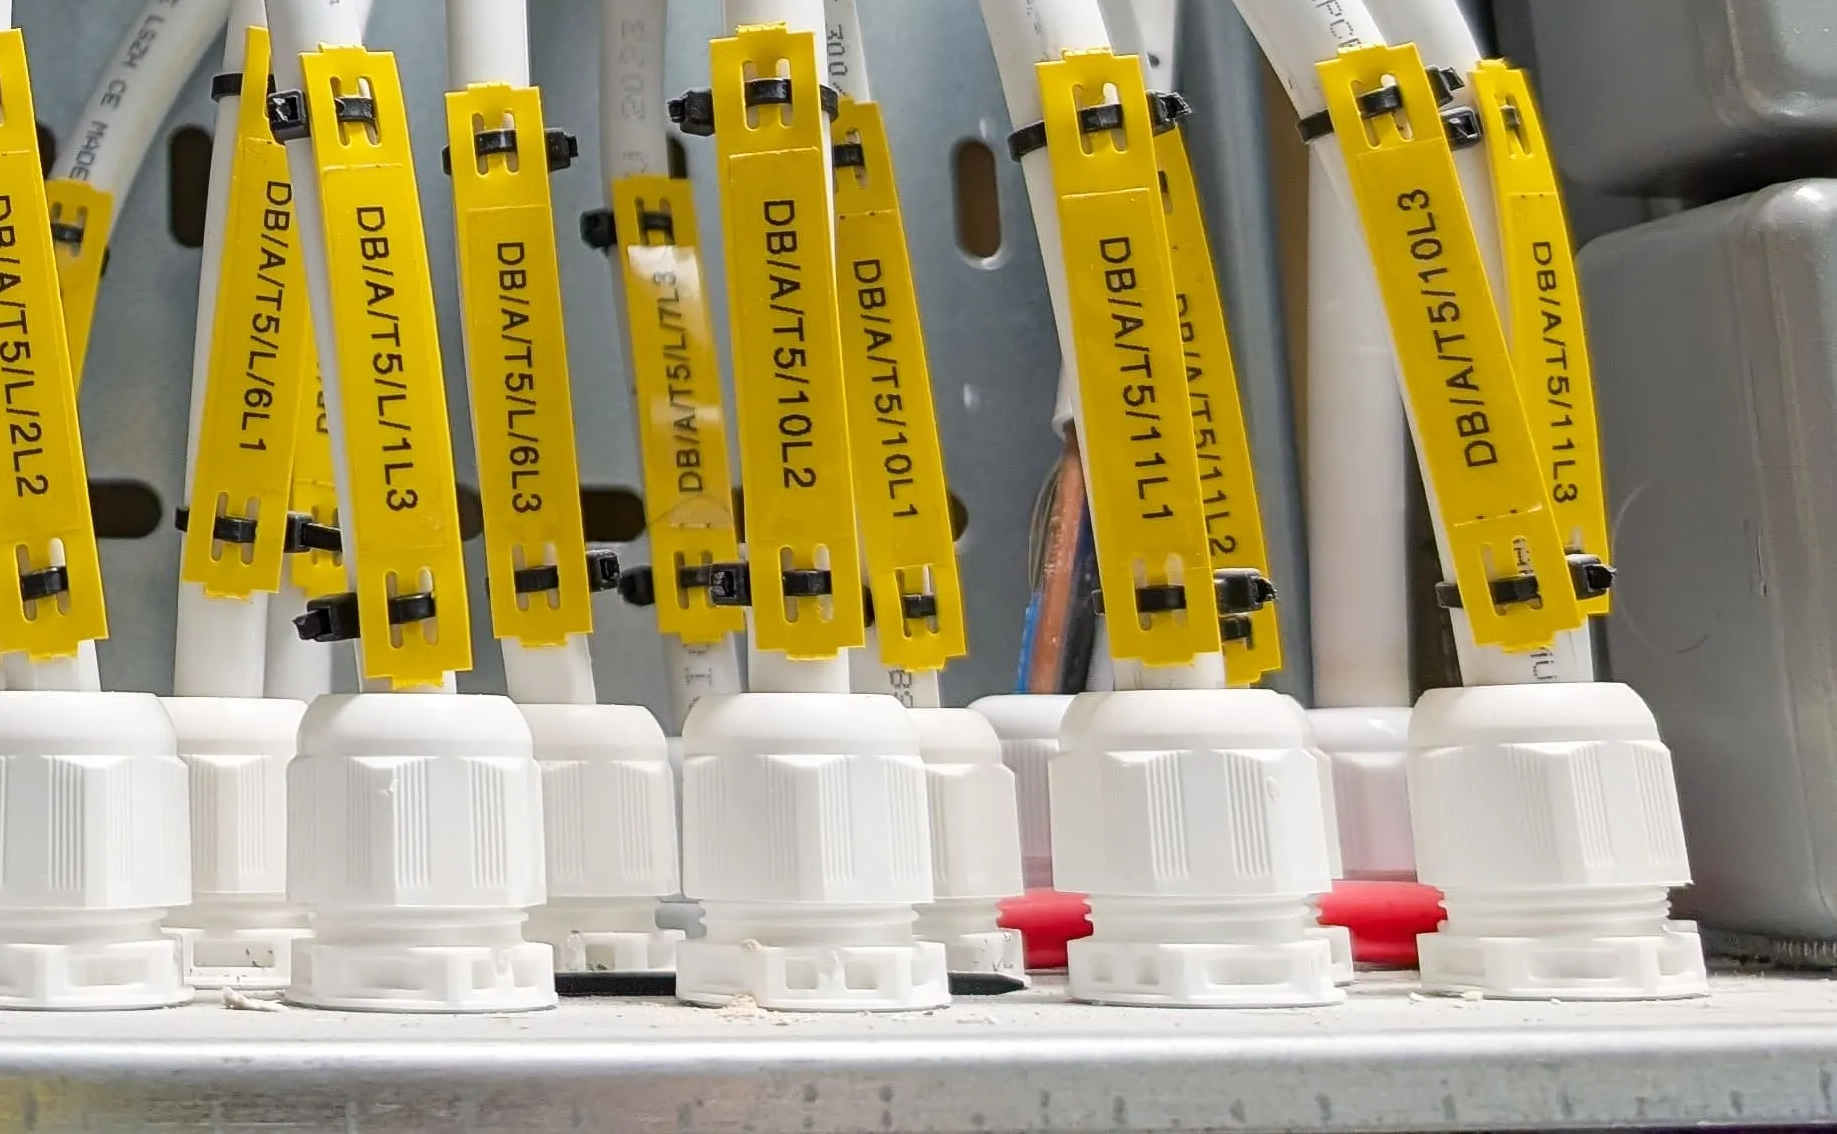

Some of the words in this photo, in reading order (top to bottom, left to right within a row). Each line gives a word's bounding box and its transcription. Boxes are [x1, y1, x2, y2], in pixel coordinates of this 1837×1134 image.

[68, 119, 108, 180] MADE
[99, 78, 128, 110] CE
[239, 180, 293, 454] DB/A/T5/L/6L1
[356, 205, 419, 513] DB/A/T5/L/1L3
[496, 241, 543, 516] DB/A/T5/L/6L3
[762, 199, 818, 491] DB/A/T5/10L2
[852, 258, 919, 520] DB/A/T5/10L1
[1098, 237, 1174, 524] DB/A/T5/11L1
[1397, 187, 1498, 468] DB/A/T5/10L3
[1531, 240, 1579, 504] DB/A/T5/11L3
